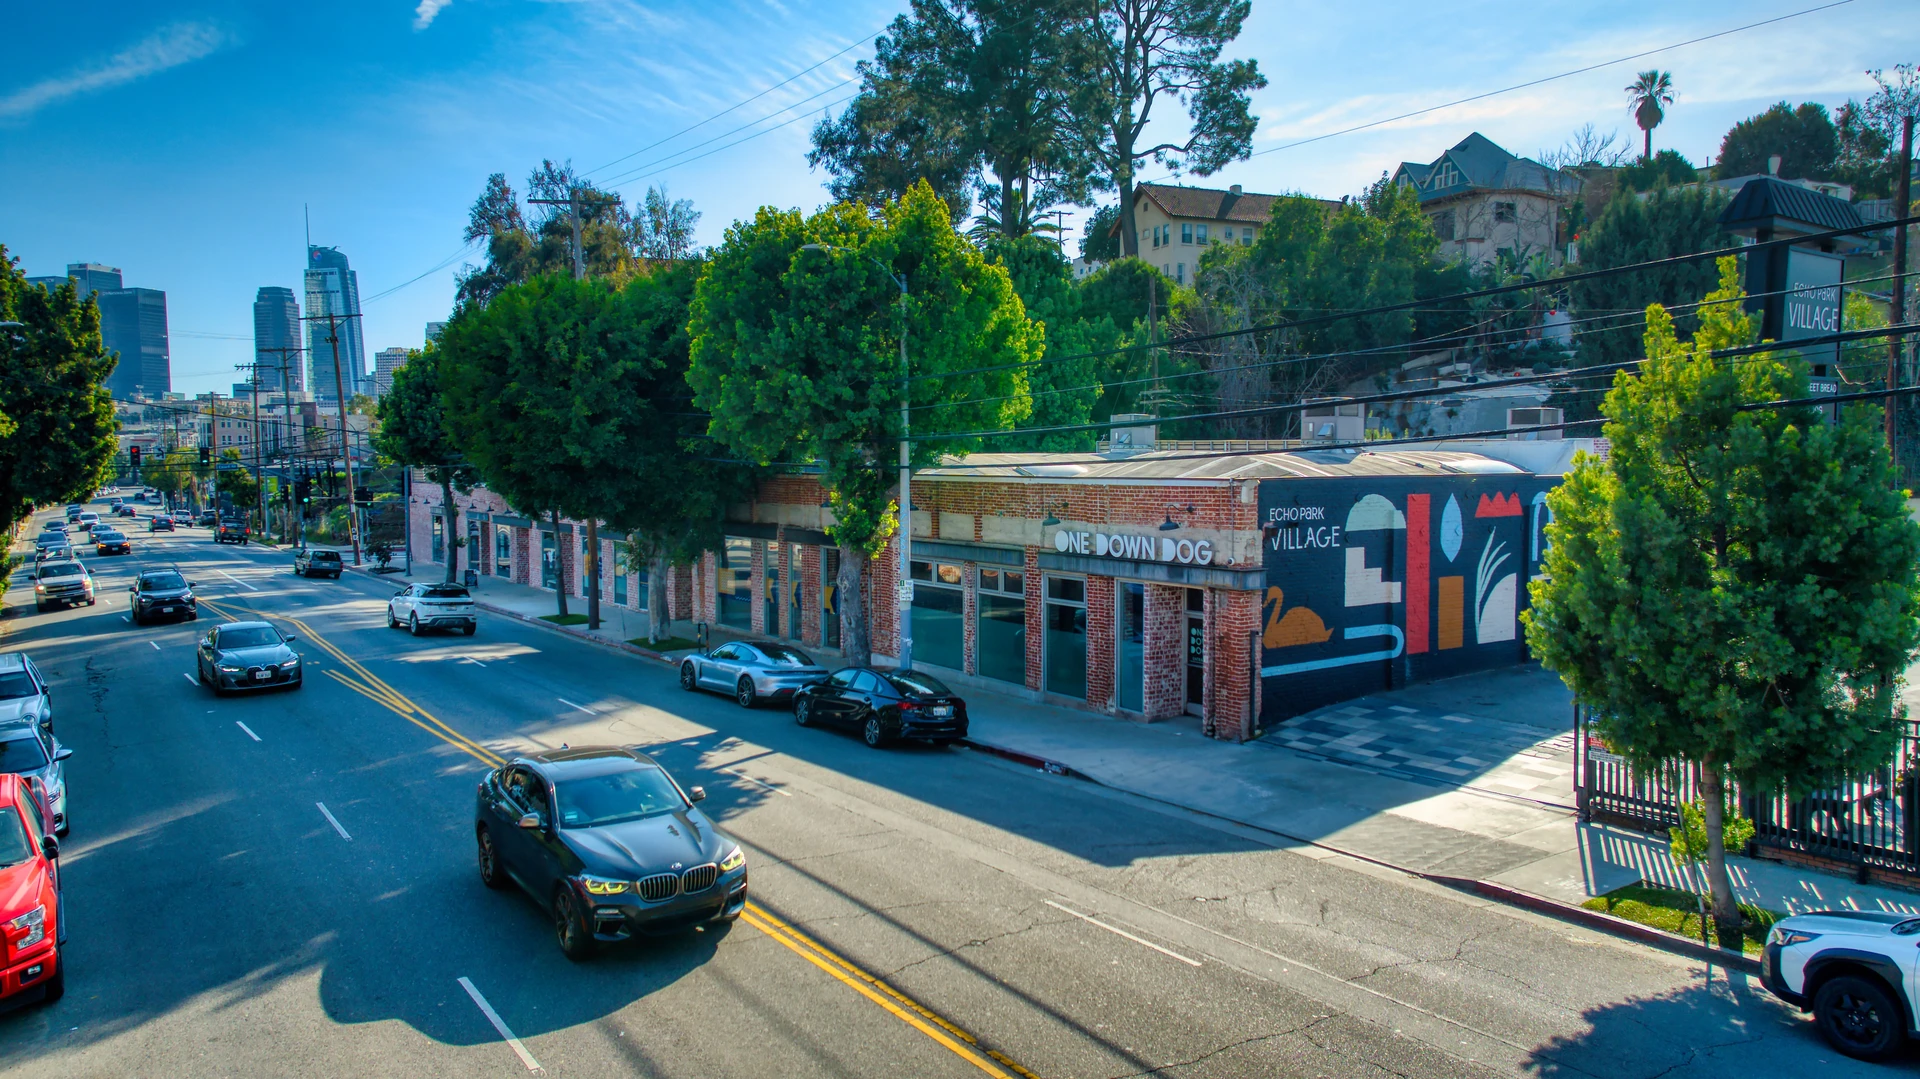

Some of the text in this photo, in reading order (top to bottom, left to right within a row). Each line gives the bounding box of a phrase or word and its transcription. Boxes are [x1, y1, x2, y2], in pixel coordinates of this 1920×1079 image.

[1789, 302, 1839, 333] VILLAGE
[1820, 383, 1837, 393] BREAD
[1269, 507, 1299, 522] ECHO
[1271, 526, 1341, 551] VILLAGE
[1054, 530, 1213, 566] ONE DOWN DOG
[1190, 636, 1203, 646] DO
[1190, 645, 1203, 655] DO
